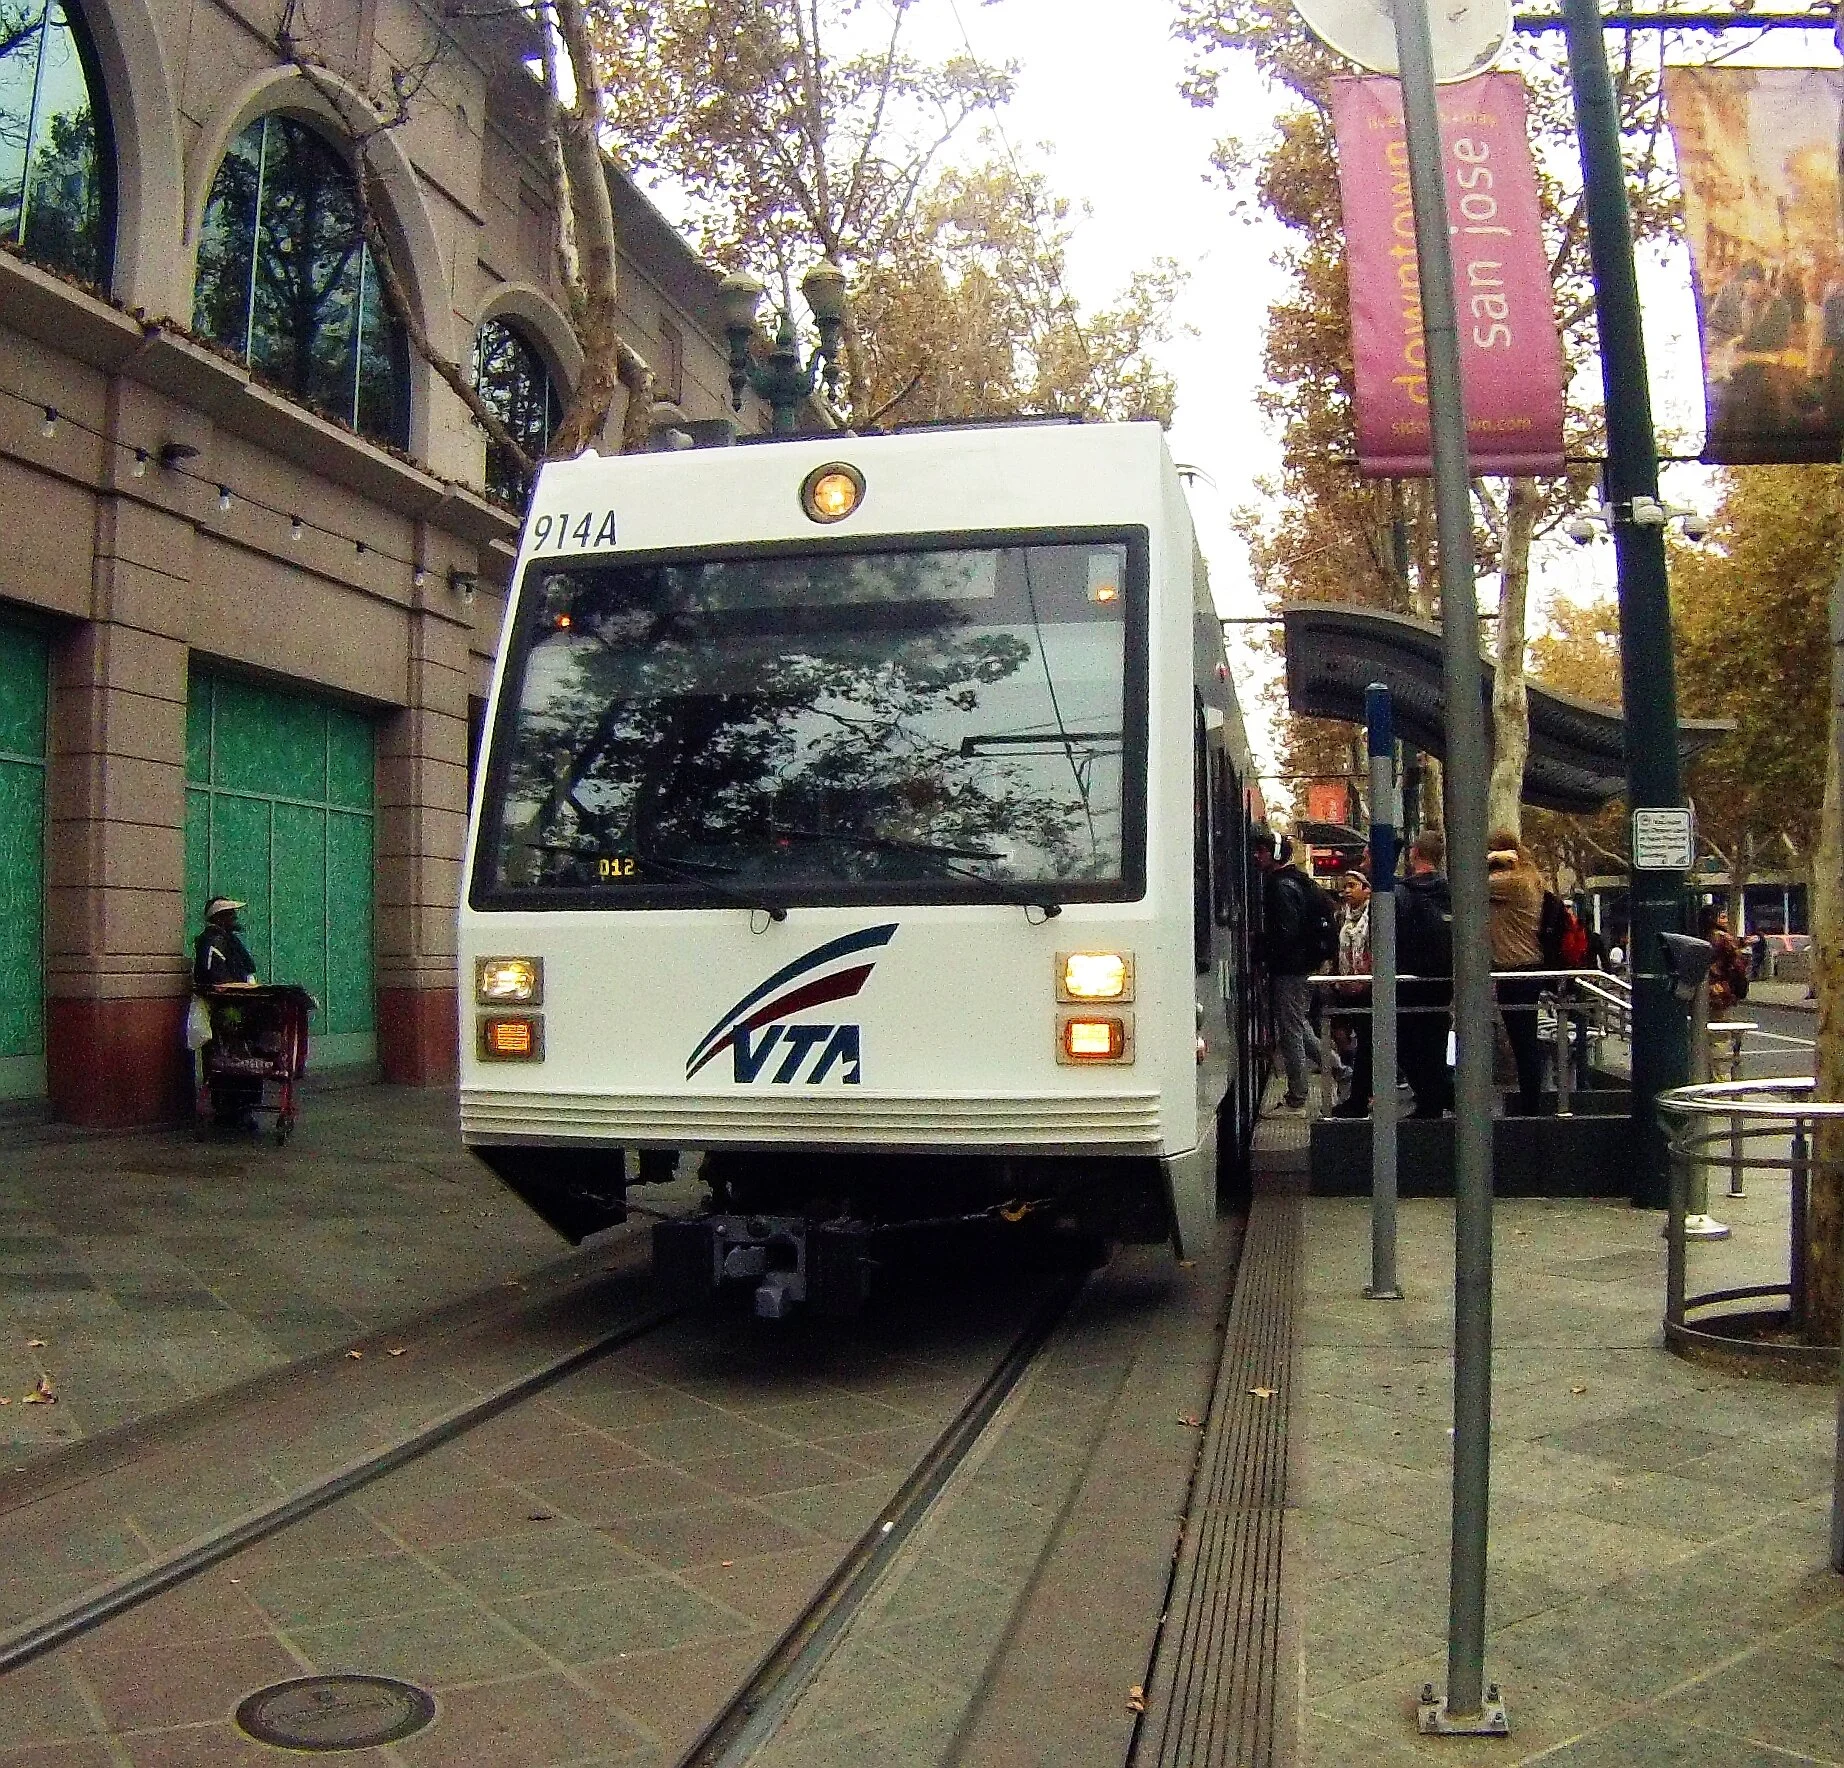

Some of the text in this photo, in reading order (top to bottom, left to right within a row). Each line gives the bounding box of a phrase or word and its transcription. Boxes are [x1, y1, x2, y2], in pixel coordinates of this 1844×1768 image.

[1448, 137, 1513, 349] san jose
[533, 509, 617, 551] 914A
[599, 858, 635, 876] 012
[733, 1023, 862, 1085] VTA
